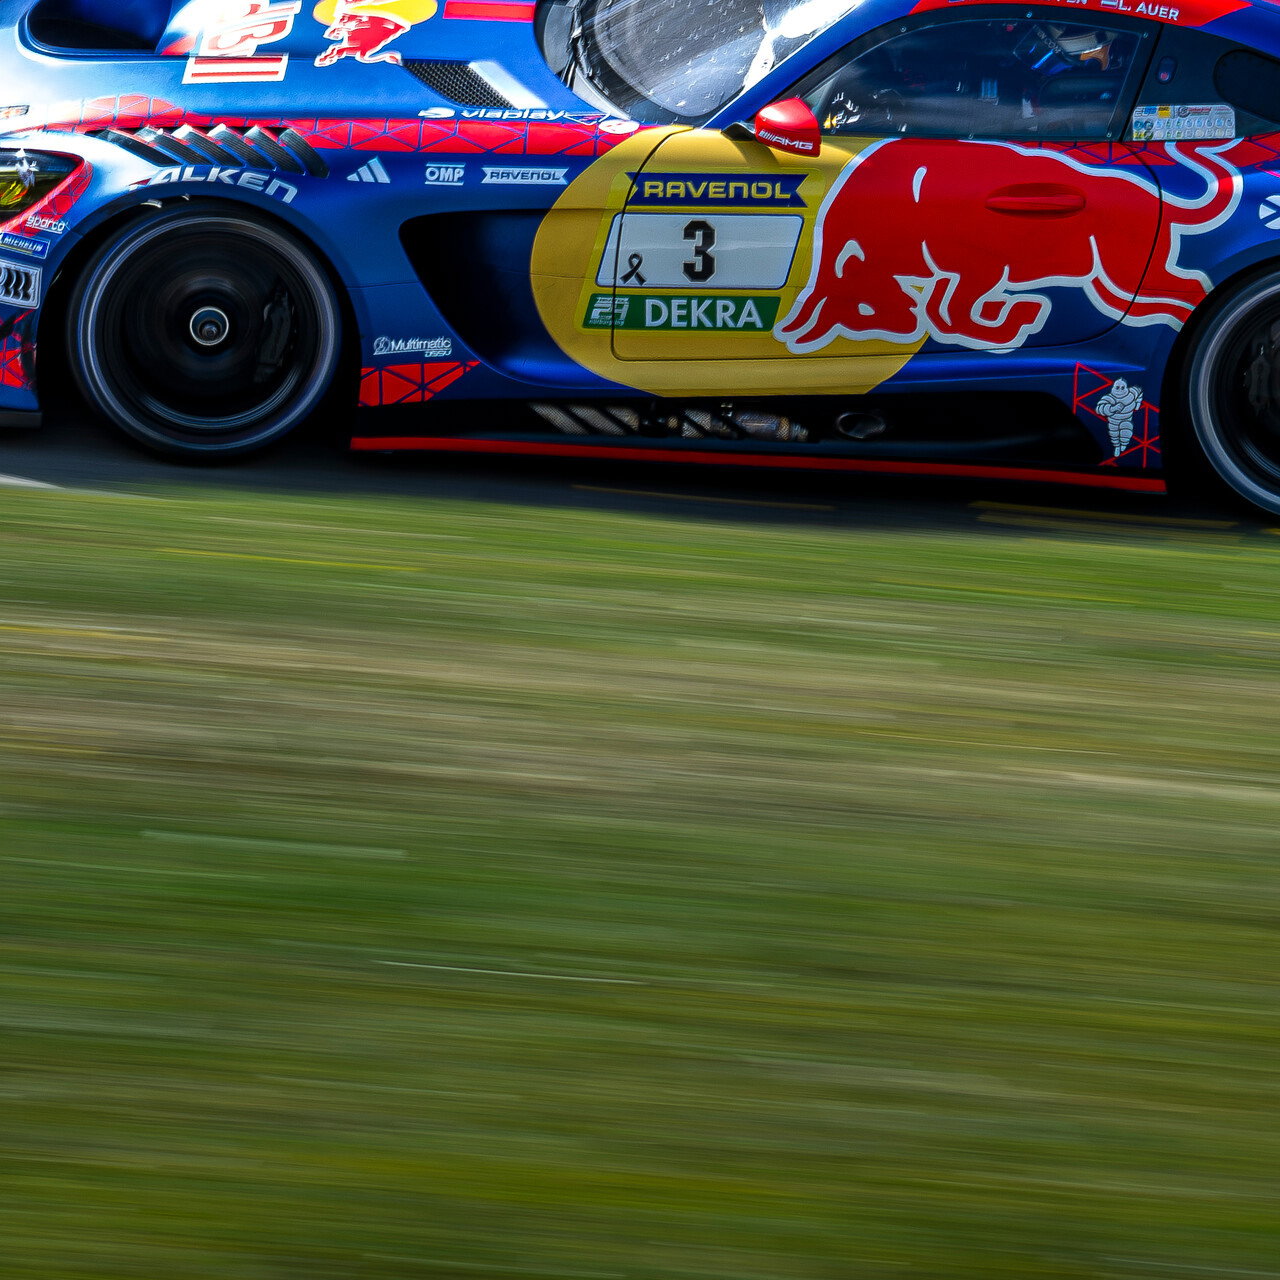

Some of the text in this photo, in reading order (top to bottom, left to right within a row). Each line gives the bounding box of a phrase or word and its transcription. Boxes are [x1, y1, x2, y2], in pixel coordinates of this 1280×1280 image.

[1135, 1, 1180, 21] AUER
[460, 108, 565, 120] viaplay
[424, 167, 466, 183] OMP
[488, 170, 561, 182] RAVENOL
[643, 180, 792, 200] RAVENOL
[3, 237, 44, 253] MICHELIN
[682, 219, 717, 284] 3
[644, 298, 764, 329] DEKRA
[391, 336, 452, 352] Multimatic
